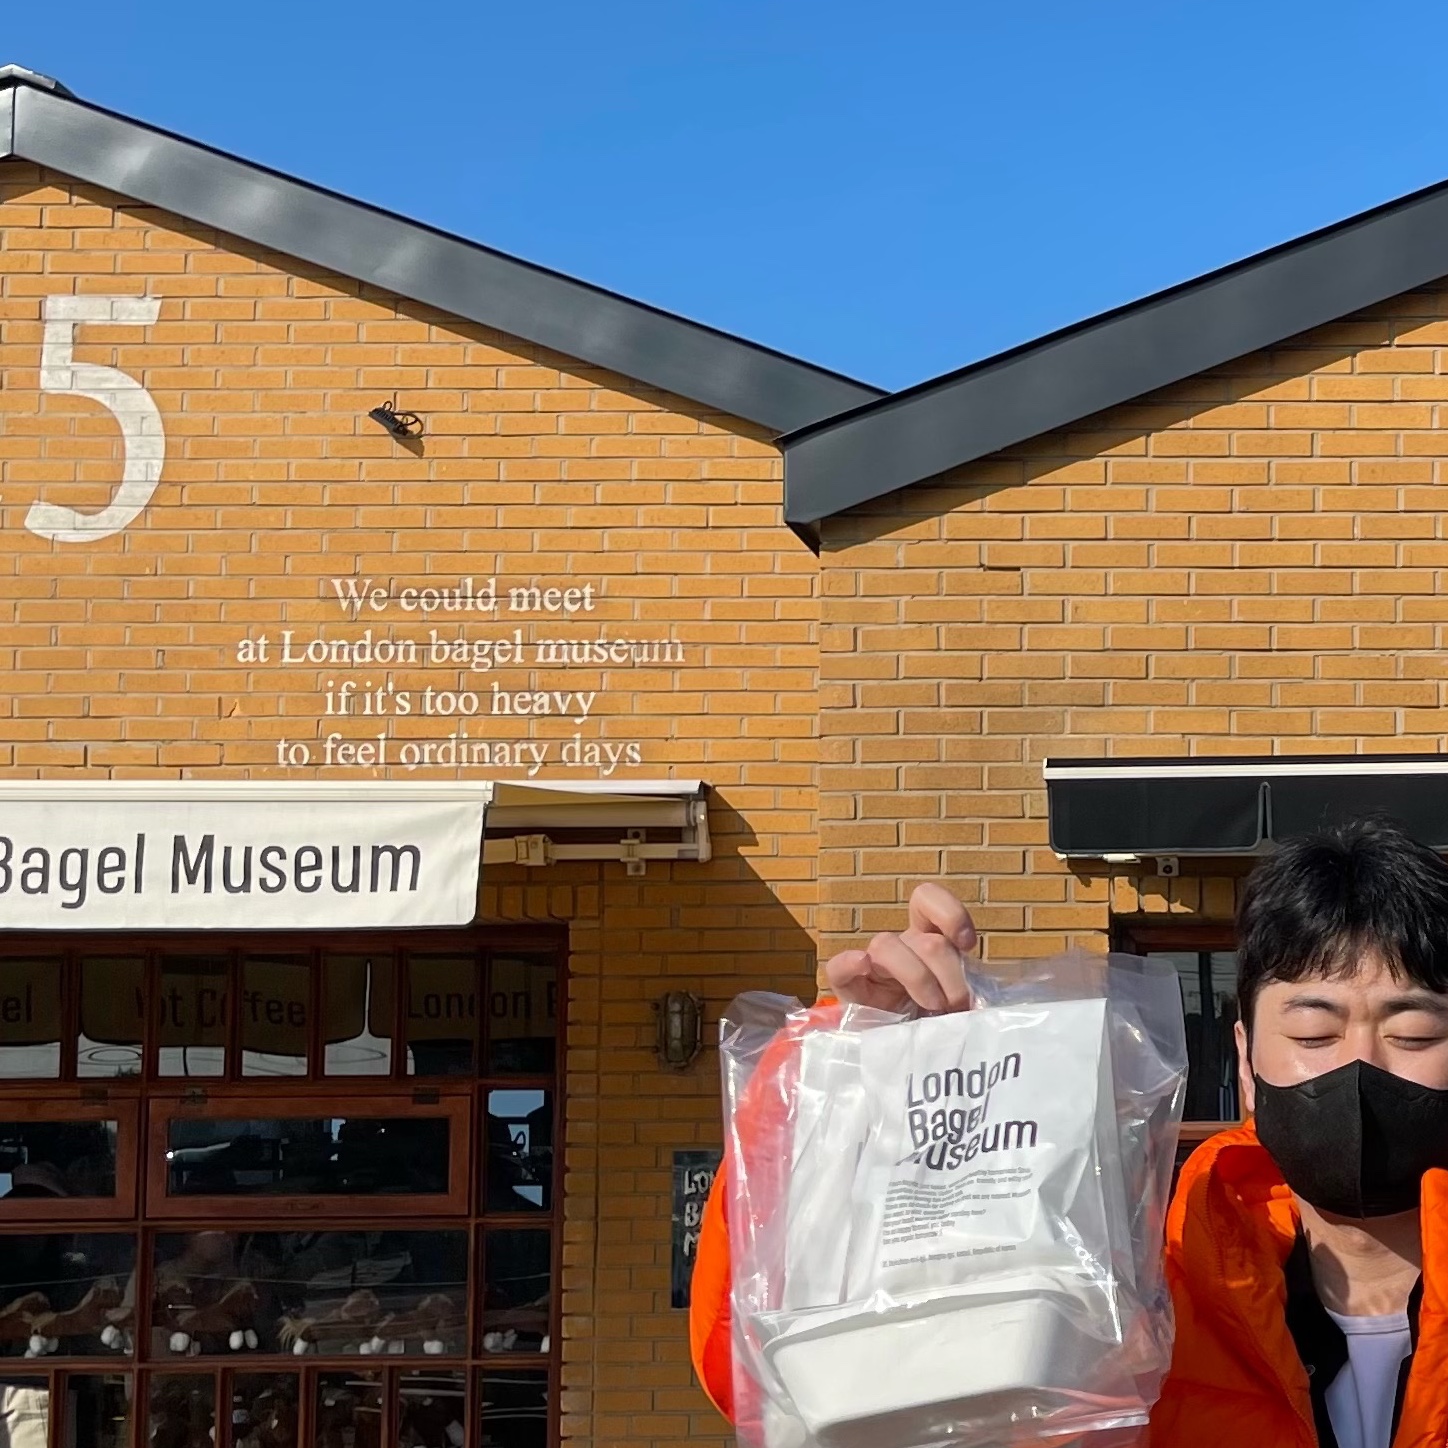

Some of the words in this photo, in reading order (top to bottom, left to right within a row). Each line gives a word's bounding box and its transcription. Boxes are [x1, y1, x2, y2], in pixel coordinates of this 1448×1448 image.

[24, 294, 162, 543] 5
[331, 578, 388, 612] We
[400, 577, 498, 612] could
[508, 581, 596, 612] meet
[236, 634, 270, 663] at
[281, 629, 418, 664] London
[429, 629, 525, 672] bagel
[535, 637, 686, 664] museum
[325, 680, 357, 715] if
[363, 680, 411, 715] it's
[424, 685, 479, 715] too
[491, 681, 597, 724] heavy
[276, 737, 310, 767] to
[323, 733, 386, 768] feel
[400, 733, 549, 776] ordinary
[562, 732, 642, 776] days
[171, 833, 421, 894] Museum
[908, 1053, 1021, 1109] London
[908, 1090, 990, 1150] Bagel
[895, 1121, 1038, 1171] useum
